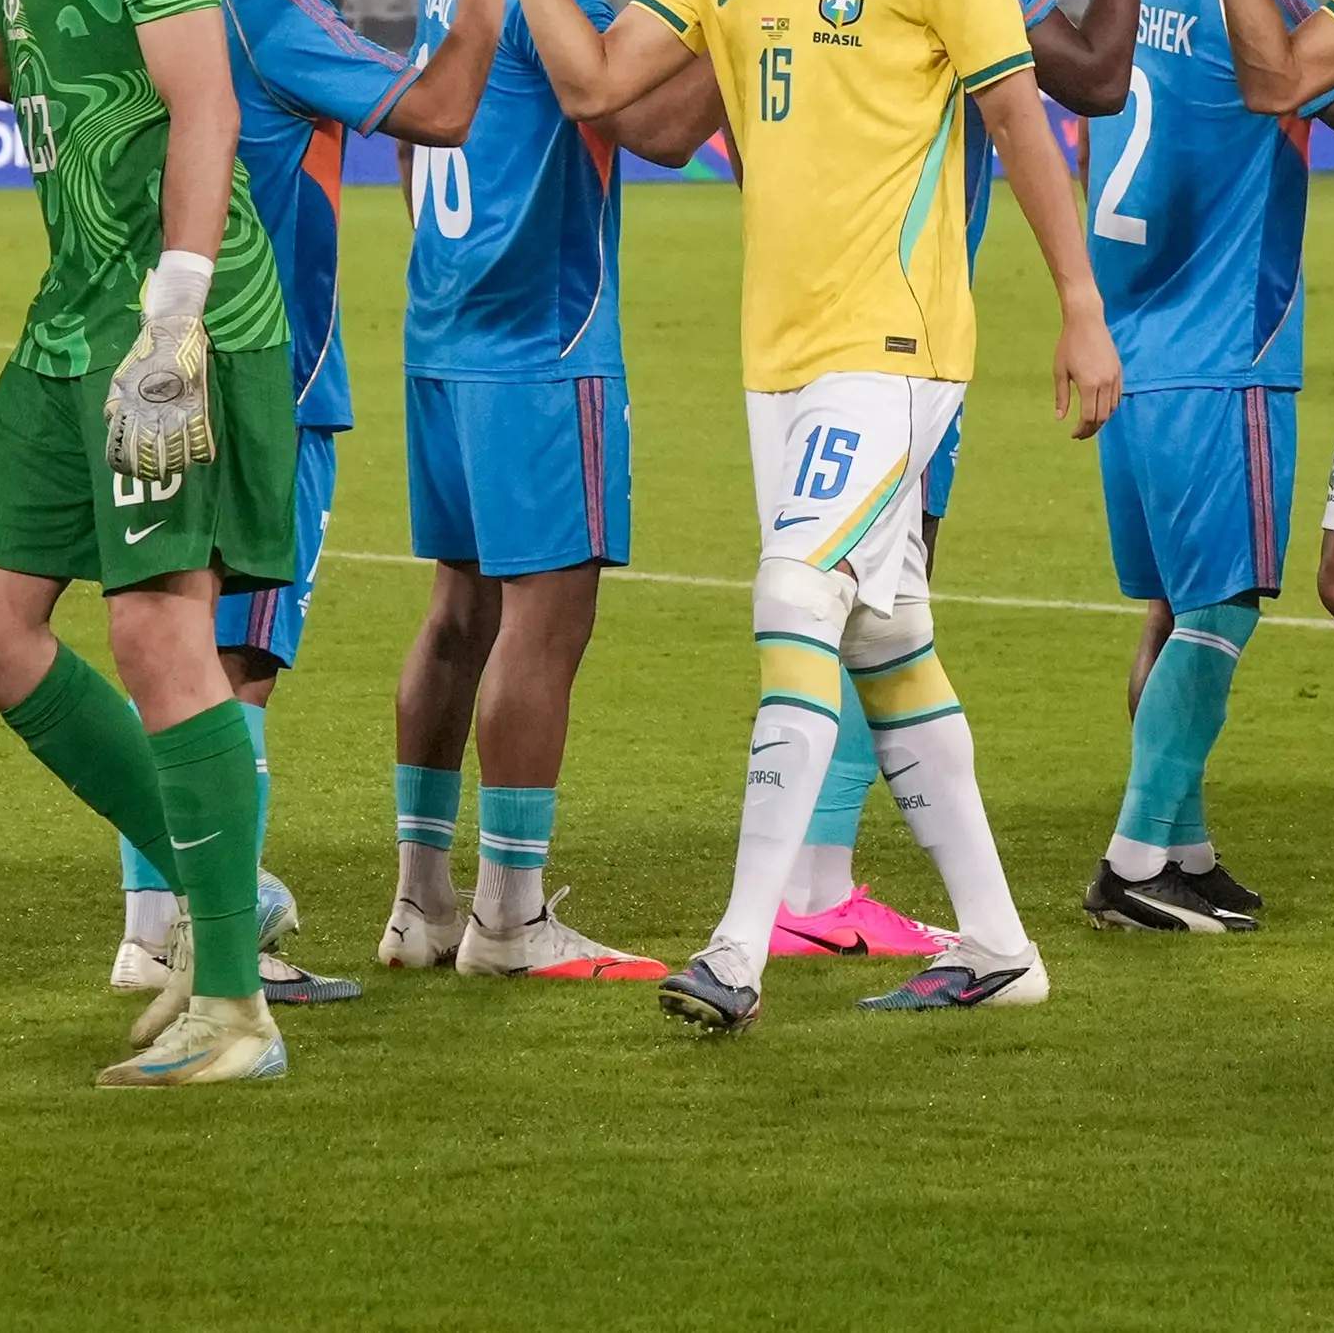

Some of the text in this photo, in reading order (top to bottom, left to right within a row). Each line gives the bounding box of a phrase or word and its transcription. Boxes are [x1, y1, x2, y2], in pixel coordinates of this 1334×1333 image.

[812, 31, 863, 47] BRASIL
[759, 47, 793, 122] 15
[19, 94, 58, 174] 23
[1093, 65, 1154, 246] 2
[793, 424, 861, 501] 15
[748, 770, 785, 789] BRASIL
[893, 793, 932, 812] RASIL
